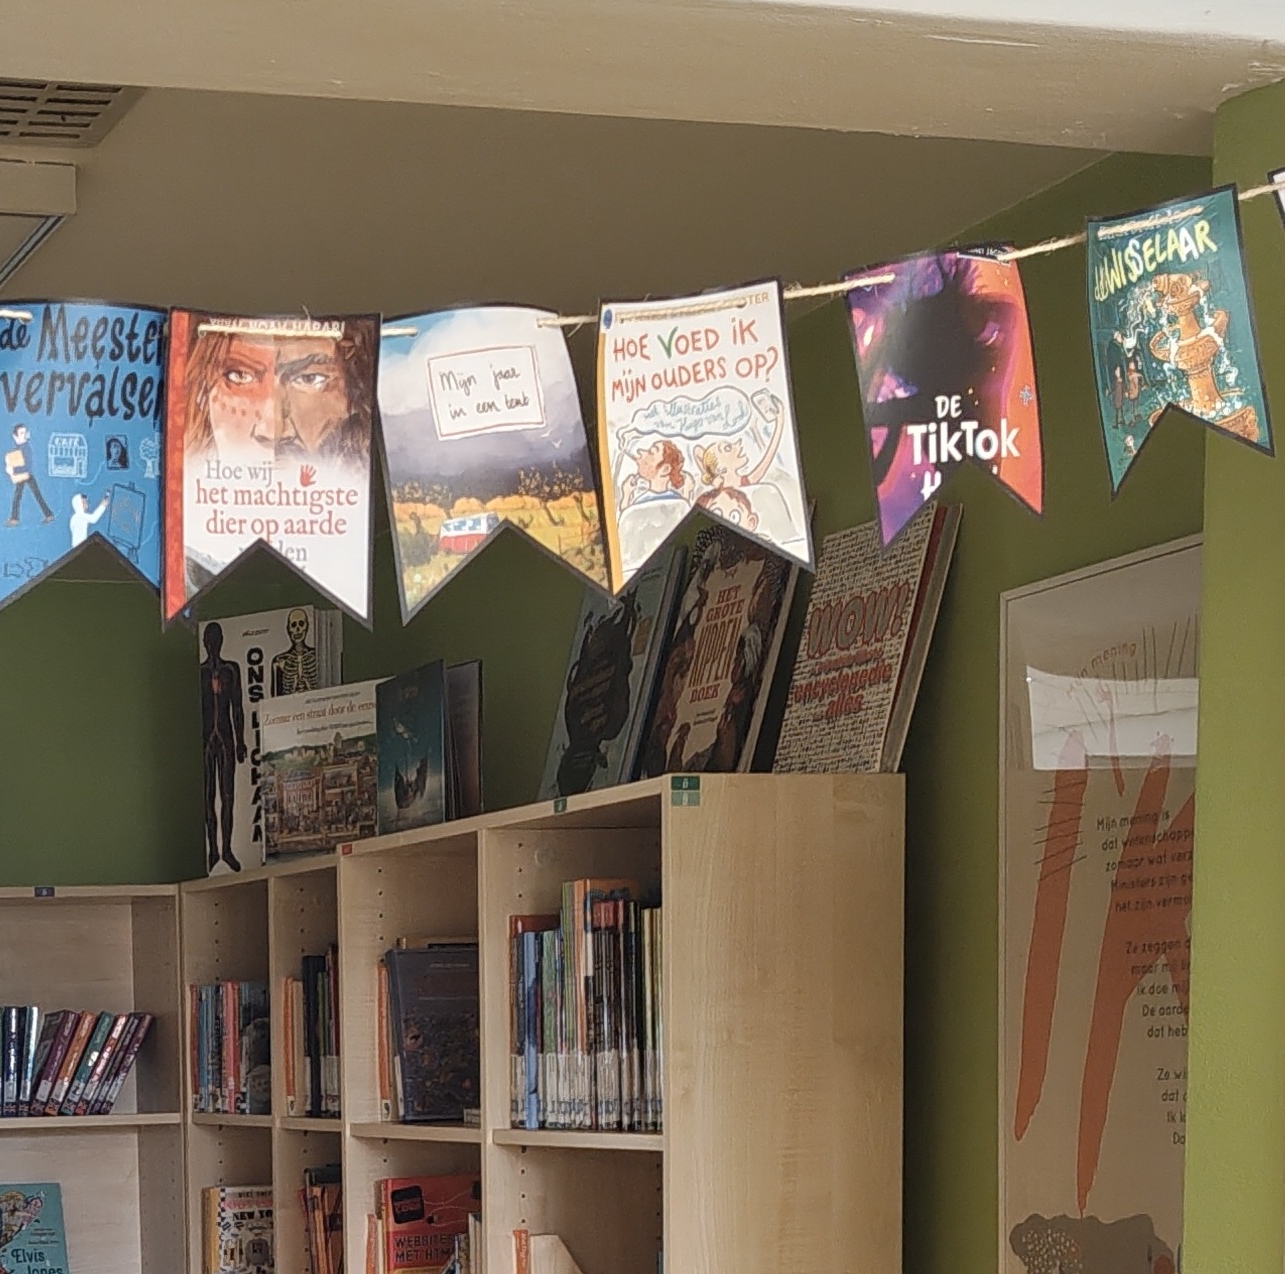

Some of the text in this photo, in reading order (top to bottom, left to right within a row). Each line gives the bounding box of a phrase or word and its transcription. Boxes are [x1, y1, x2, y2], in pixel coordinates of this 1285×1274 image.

[613, 333, 650, 362] HOE
[657, 326, 720, 358] VOED
[652, 356, 727, 391] OUDERS
[736, 346, 778, 382] OP?
[438, 364, 520, 396] Mijn jaar
[448, 404, 466, 420] in
[476, 401, 500, 414] een
[935, 395, 962, 418] DE
[907, 418, 1020, 465] TikTok
[206, 459, 273, 488] Hoe wij
[196, 479, 359, 515] het machtigste
[206, 509, 348, 541] dier op aarde
[718, 585, 741, 604] HET
[706, 599, 745, 622] GROTE
[247, 647, 264, 703] ONS
[690, 683, 720, 703] BOEK
[1142, 1004, 1156, 1017] De
[1147, 1025, 1164, 1038] dat
[1157, 1068, 1170, 1081] Ze
[1161, 1089, 1179, 1102] dat
[233, 1211, 255, 1220] NEW
[11, 1248, 45, 1264] Elvis
[396, 1249, 420, 1262] MET
